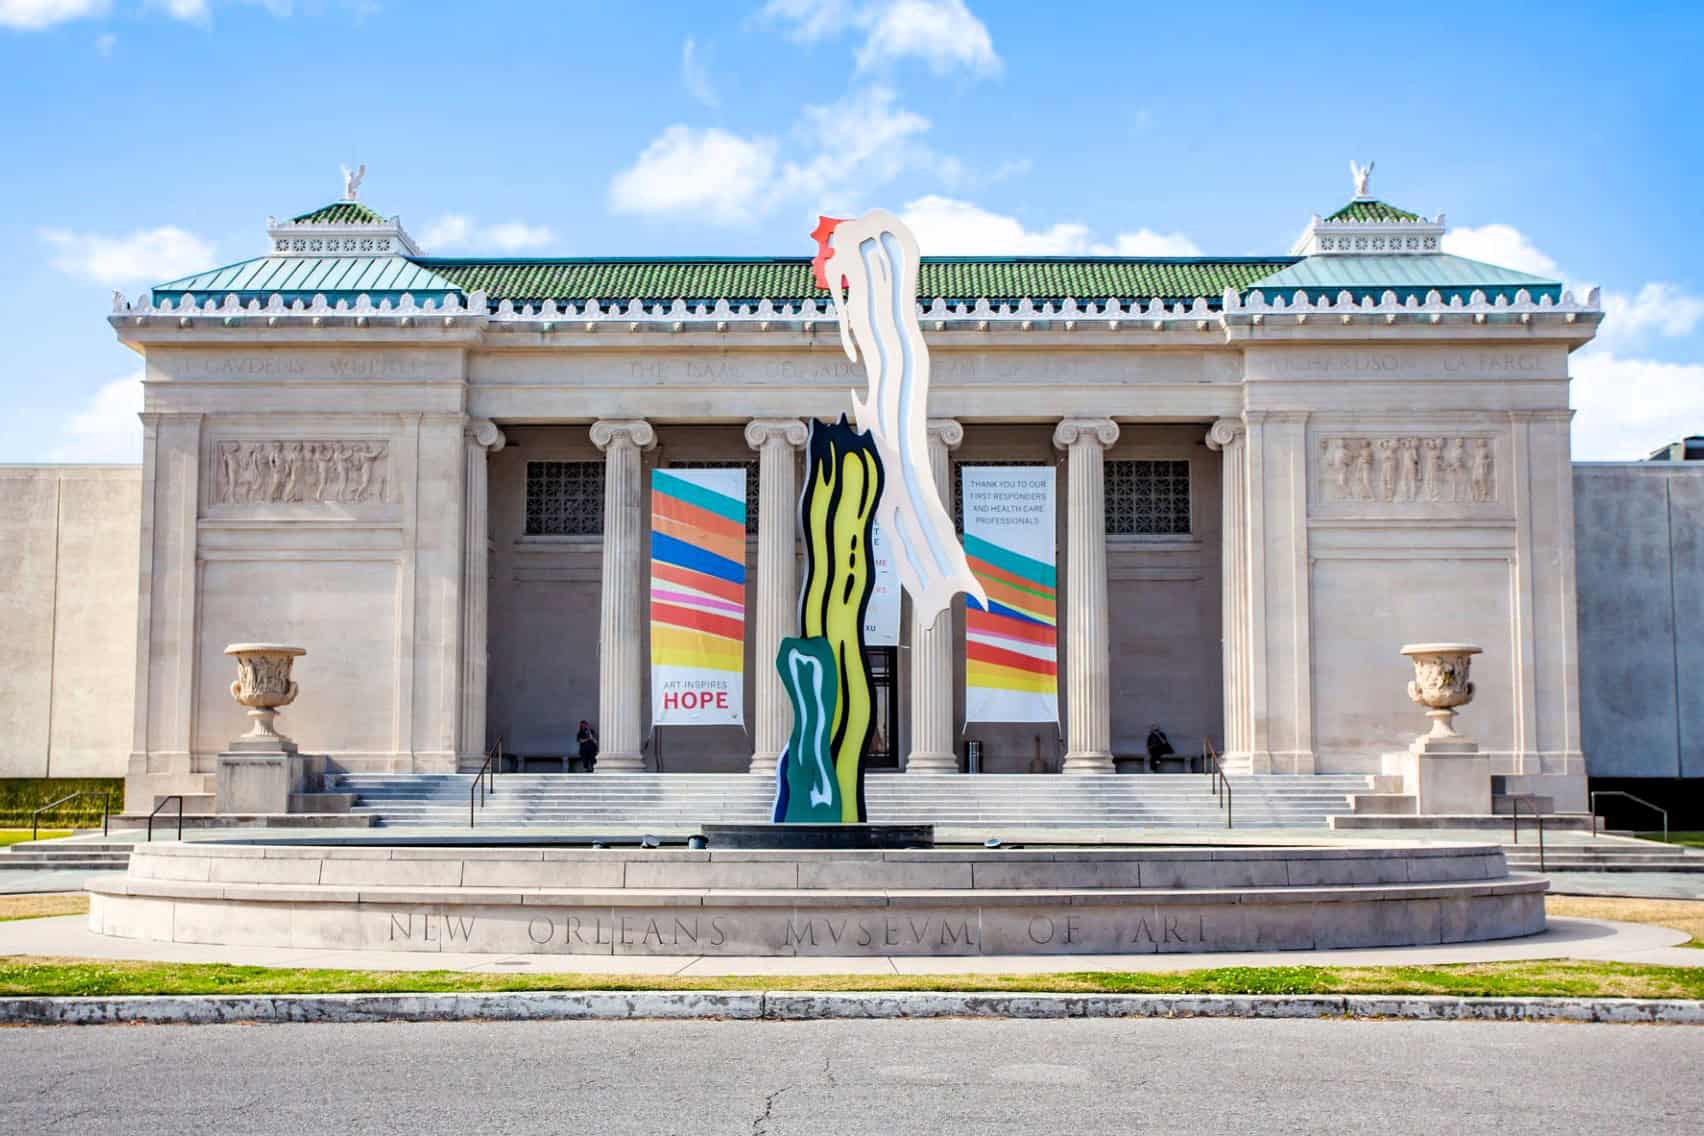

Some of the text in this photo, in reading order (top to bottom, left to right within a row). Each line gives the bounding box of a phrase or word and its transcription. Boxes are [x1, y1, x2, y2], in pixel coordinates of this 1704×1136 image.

[970, 480, 1046, 489] THANK YOU TO OUR
[970, 493, 1047, 501] FIRST RESPONDERS
[973, 505, 1043, 513] AND HEALTH CARE
[975, 517, 1040, 525] PROFESSIONALS
[663, 681, 729, 689] ART INSPIRES
[663, 691, 729, 710] HOPE
[388, 912, 1208, 947] NEW ORLEANS MVSEVM OF ART
